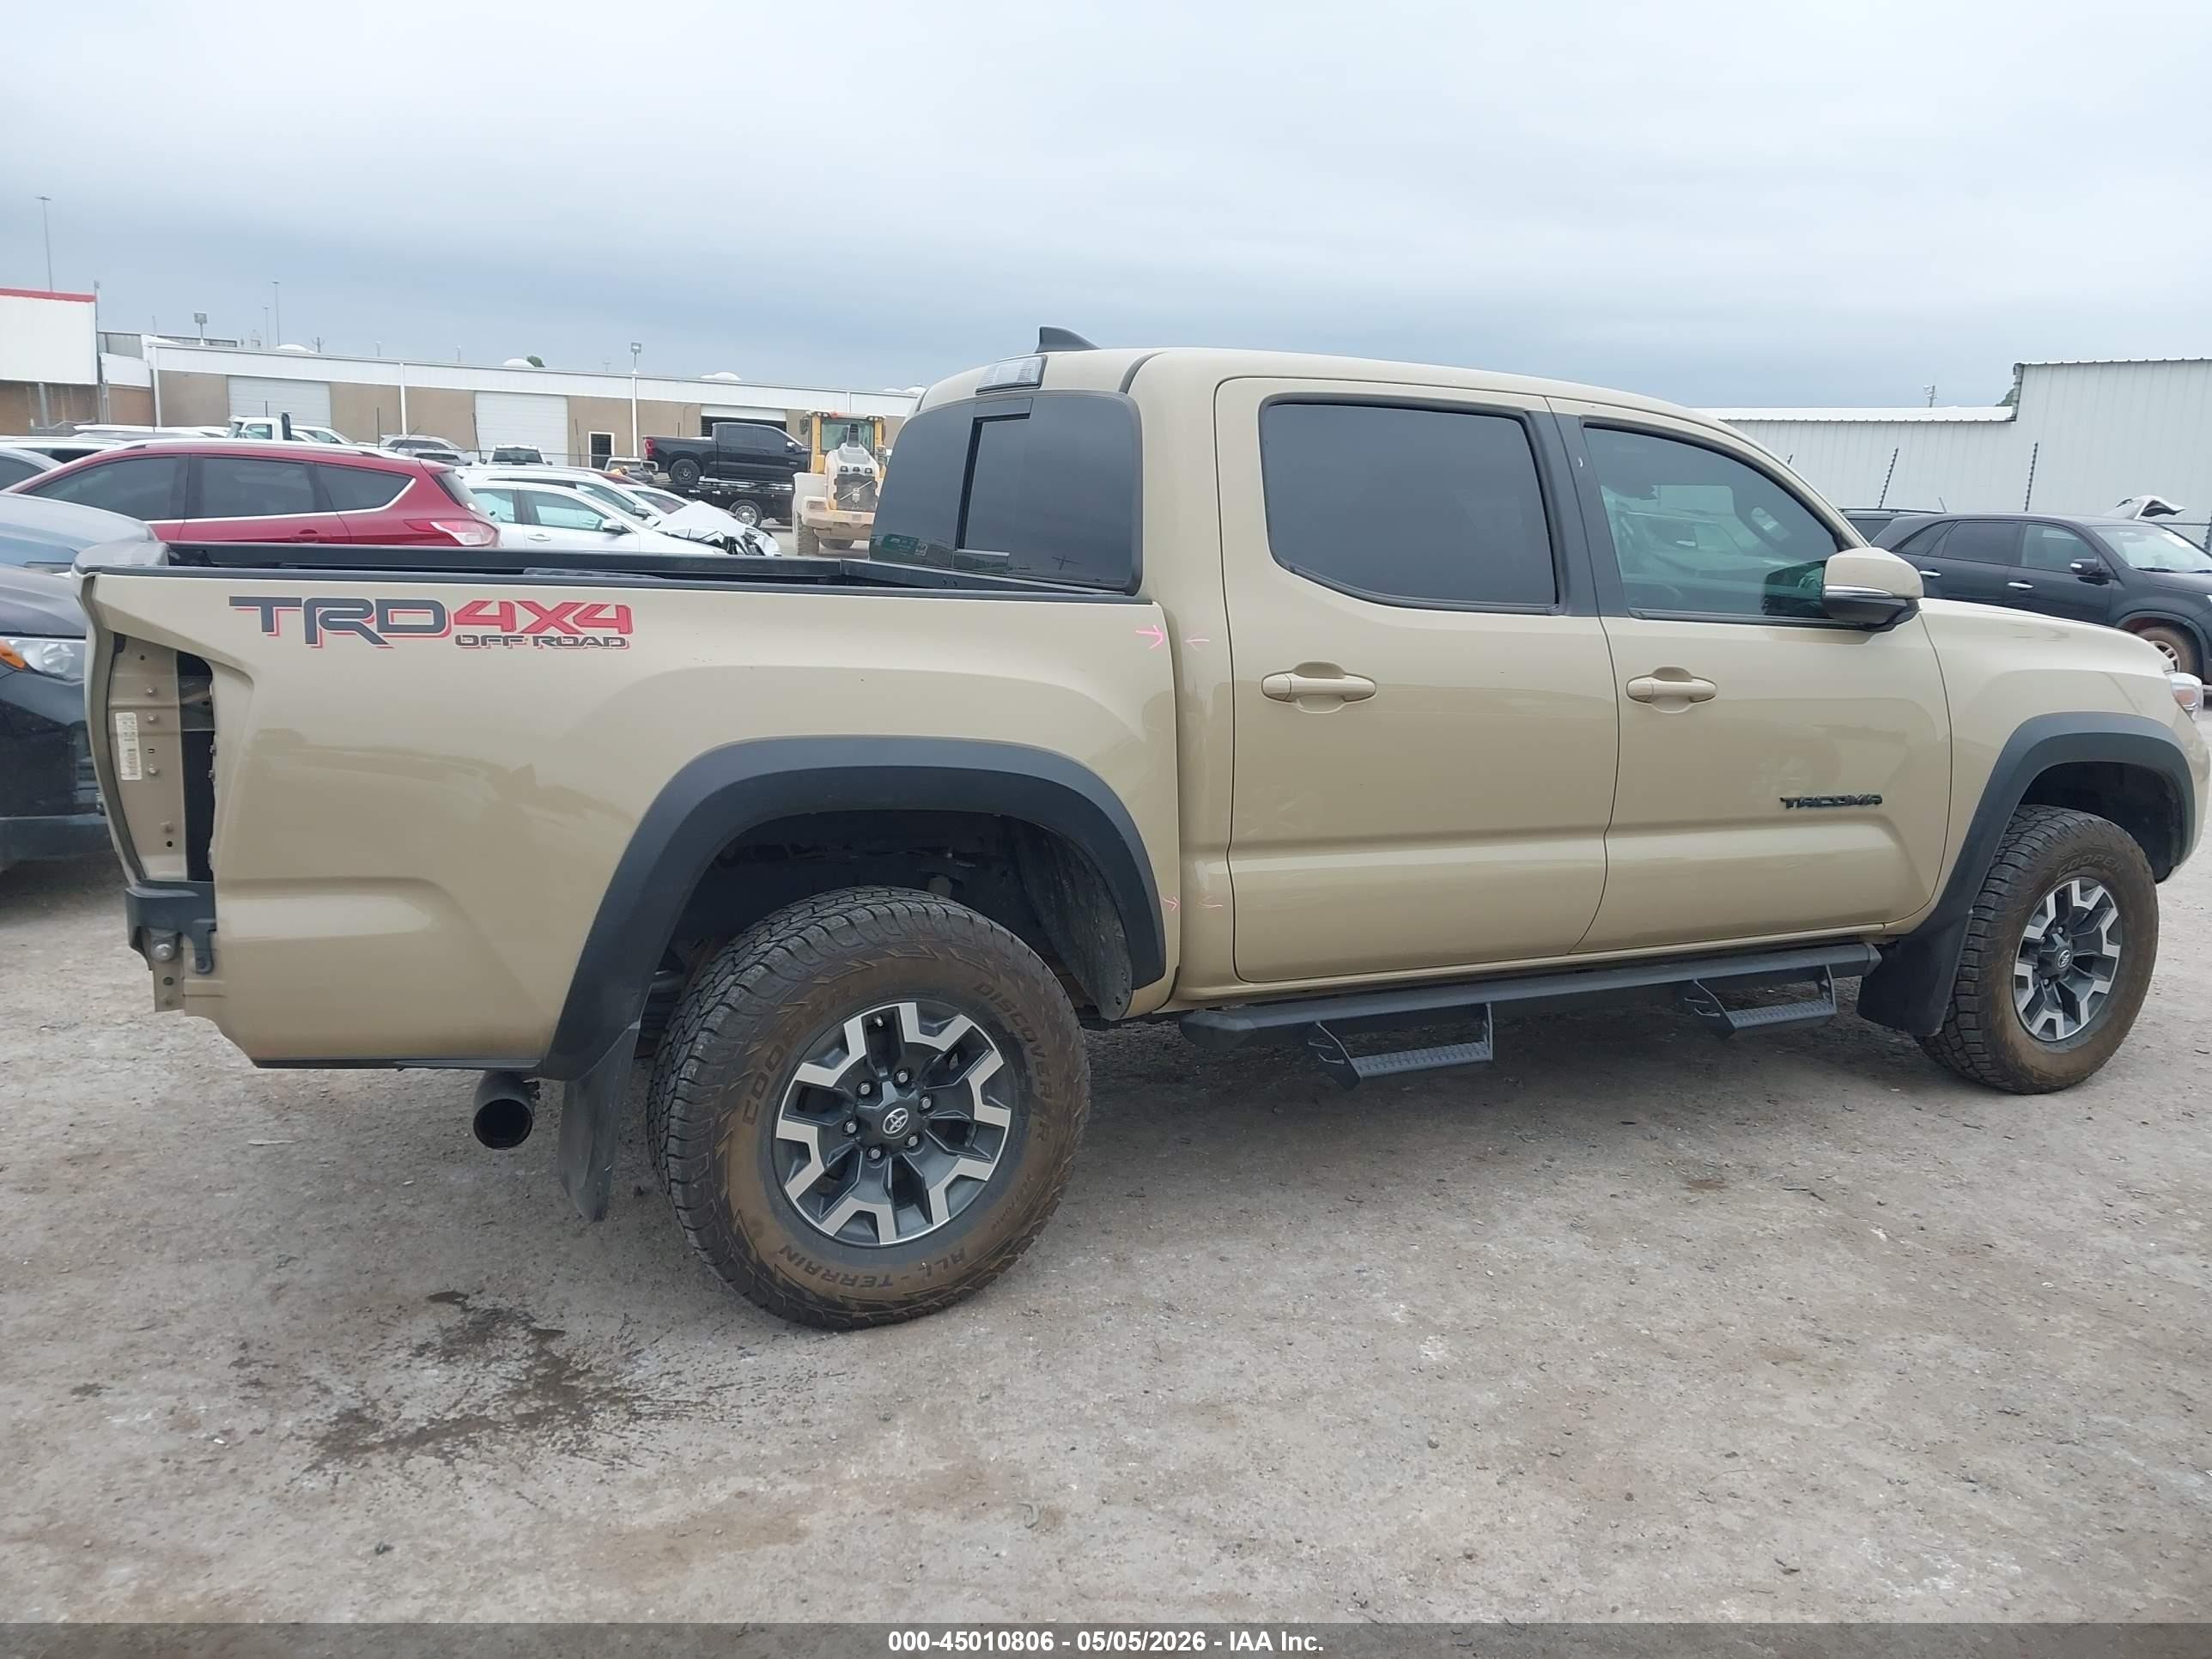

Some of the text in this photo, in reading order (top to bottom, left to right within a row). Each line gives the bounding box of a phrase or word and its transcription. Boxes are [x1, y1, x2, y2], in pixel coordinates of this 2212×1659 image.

[229, 596, 452, 648] TRD
[454, 634, 631, 649] OFF ROAD
[1778, 793, 1883, 809] TACOMA
[2057, 854, 2124, 878] COOPER
[741, 985, 854, 1127] COOPER
